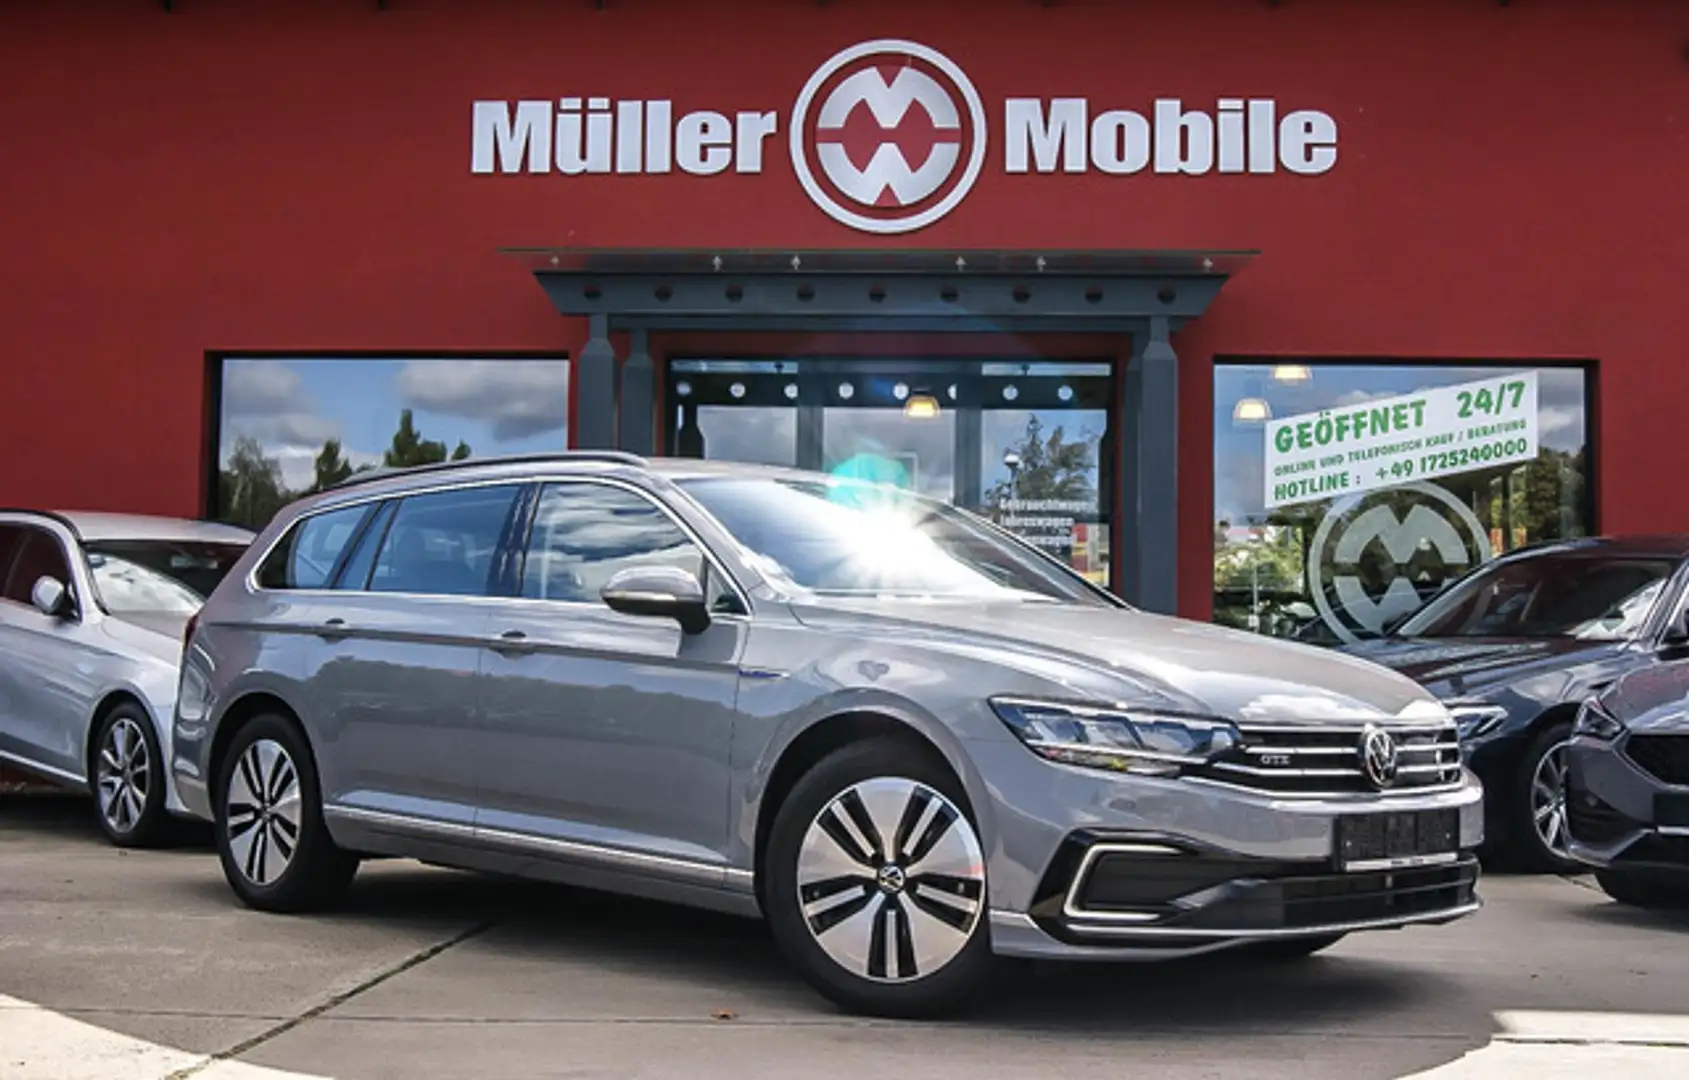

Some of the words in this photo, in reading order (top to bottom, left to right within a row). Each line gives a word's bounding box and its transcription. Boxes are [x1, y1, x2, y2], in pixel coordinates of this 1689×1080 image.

[471, 97, 777, 174] Müller
[1005, 98, 1338, 175] Mobile
[1274, 400, 1427, 454] GEÖFFNET
[1456, 380, 1526, 419] 24/7
[1274, 459, 1316, 477] ONLINE
[1319, 454, 1345, 468] UND
[1348, 440, 1423, 462] TELEFONISCH
[1425, 432, 1454, 447] KAUF
[1467, 418, 1527, 440] BERATUNG
[1274, 471, 1349, 501] HOTLINE
[1375, 459, 1414, 480] +49
[1420, 438, 1528, 473] 1725240000
